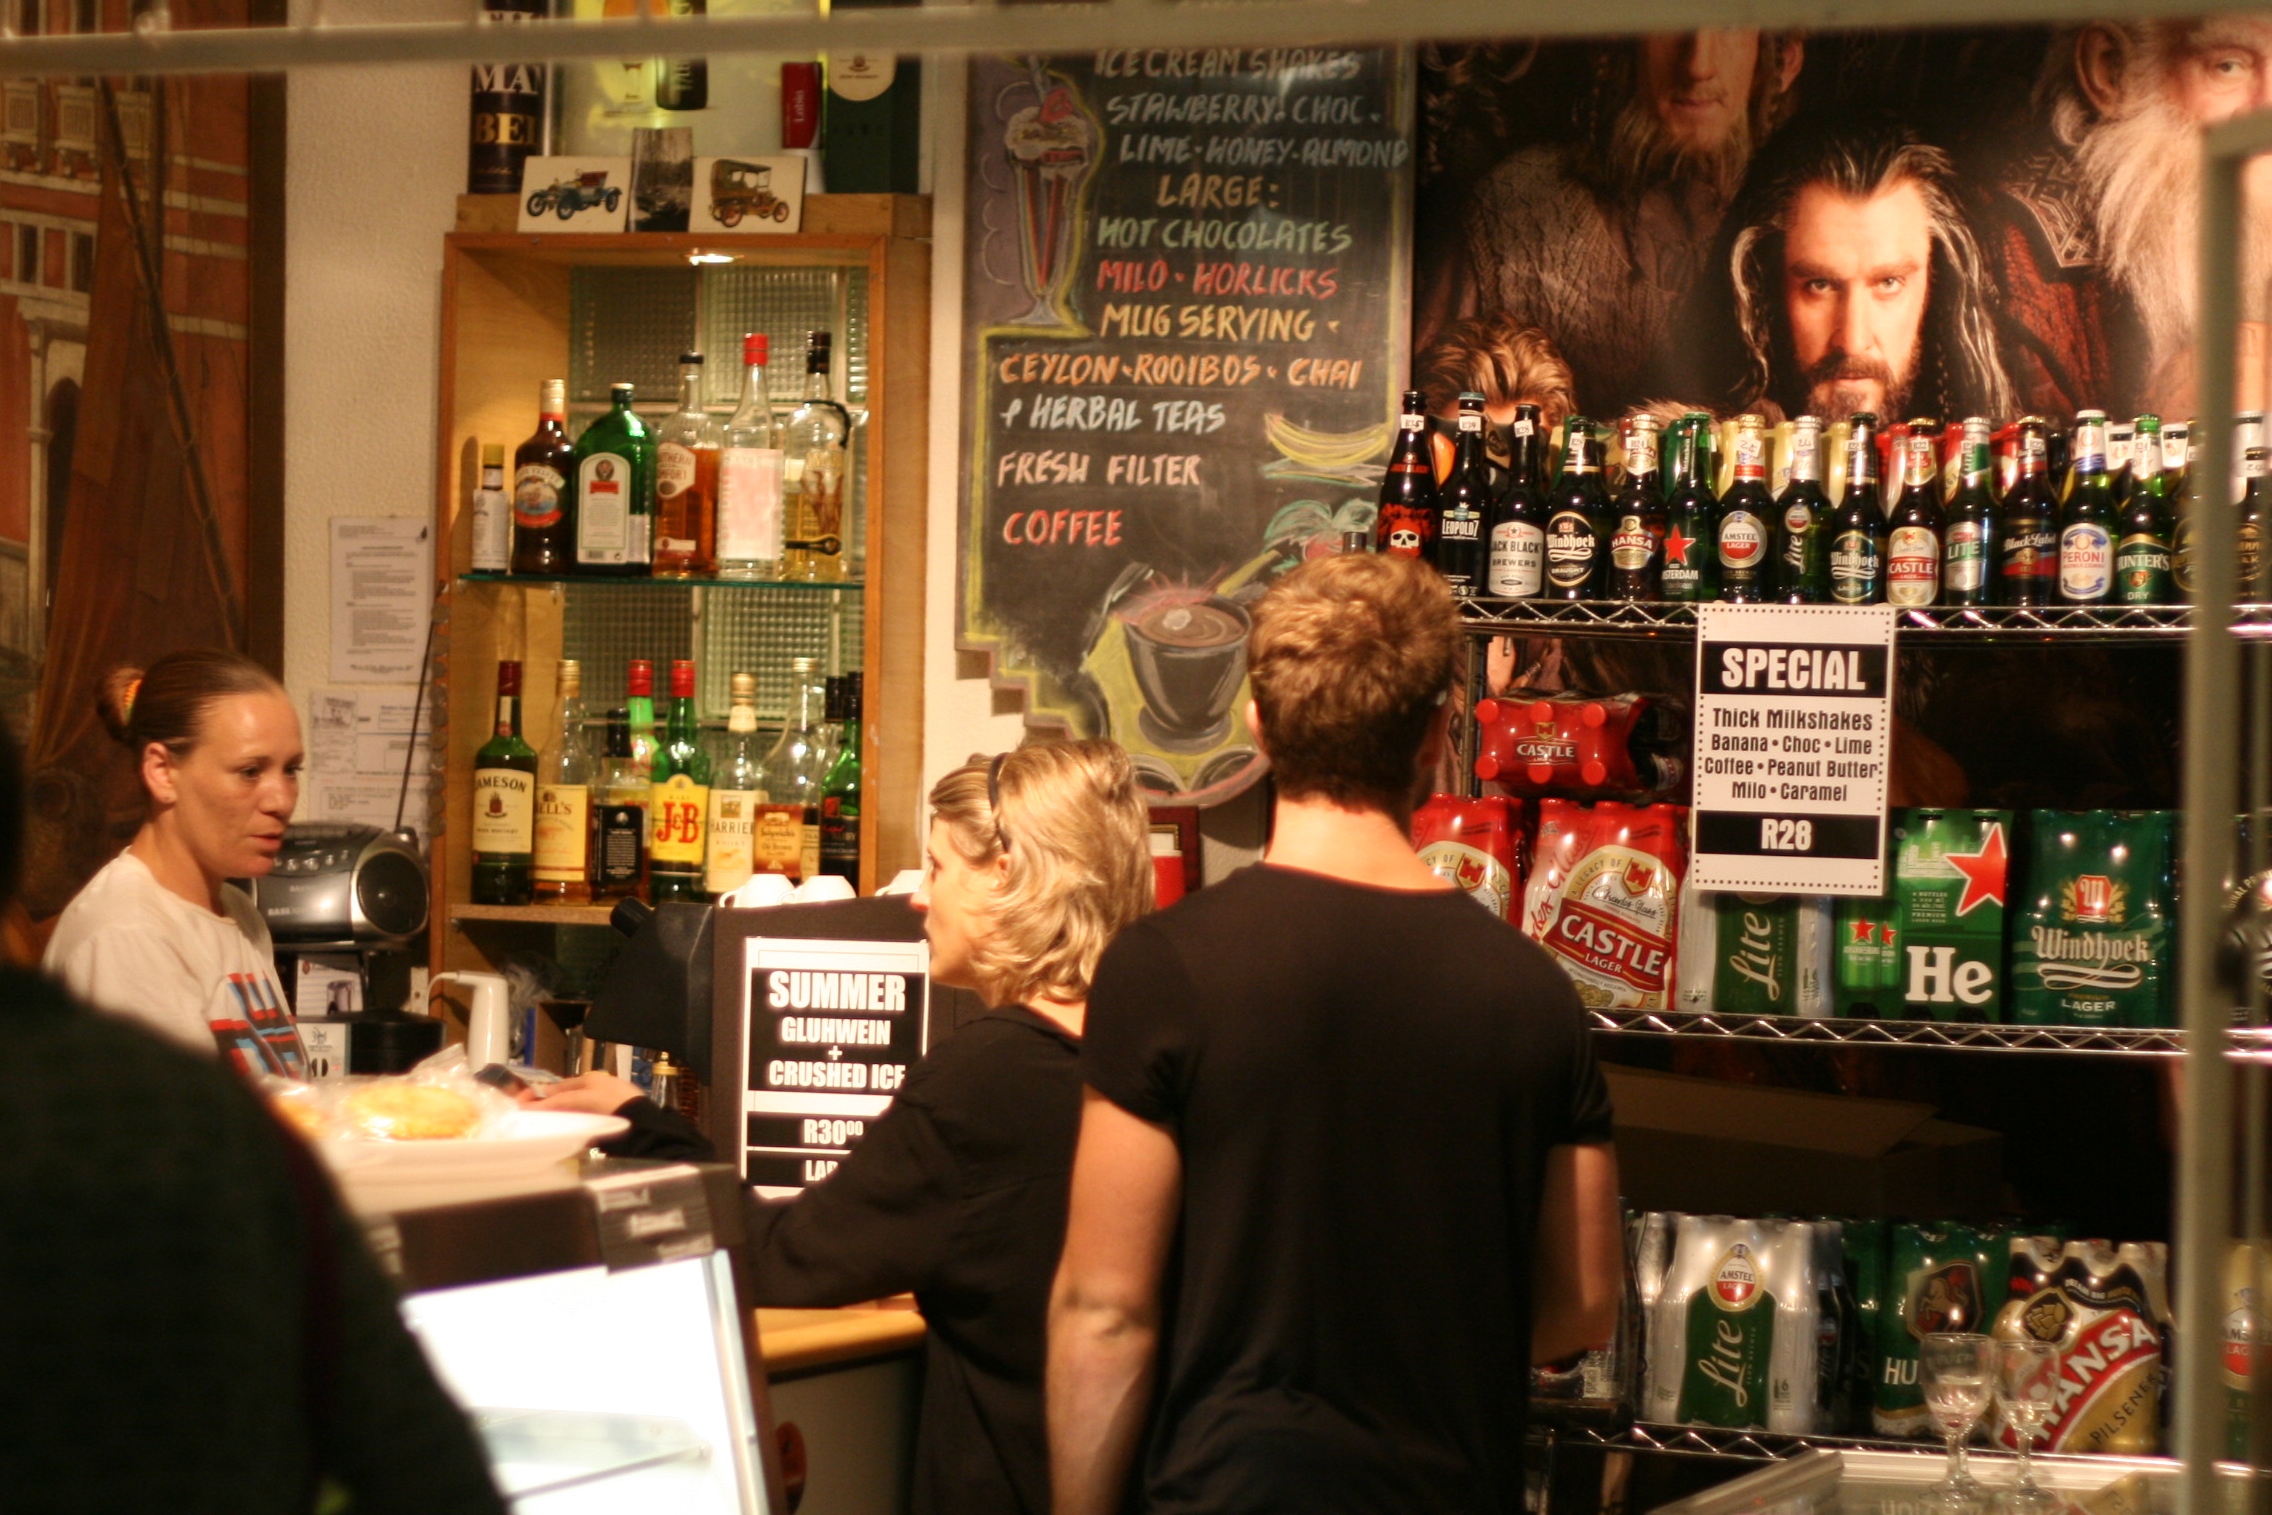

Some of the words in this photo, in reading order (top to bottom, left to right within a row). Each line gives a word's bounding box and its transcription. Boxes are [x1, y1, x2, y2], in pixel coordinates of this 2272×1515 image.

[1097, 216, 1151, 247] HOT
[1162, 218, 1353, 254] CHOCOLATES
[1096, 259, 1169, 293] MILO
[1193, 262, 1339, 300] HORLICKS
[1101, 304, 1171, 338] MUG
[1179, 304, 1315, 342] SERVING
[1287, 358, 1363, 390] CHAI
[1030, 393, 1143, 431] HERBAL
[1153, 400, 1226, 435] TEAS
[998, 449, 1090, 487] FRESH
[1107, 453, 1201, 486] FILTER
[1003, 509, 1123, 547] COFFEE
[1723, 531, 1757, 541] AMSTEL
[1547, 533, 1596, 551] Windhoek
[1611, 535, 1654, 550] HANSA
[1726, 541, 1751, 550] LAGER
[1947, 540, 1981, 560] LITE
[1492, 558, 1538, 569] BREWERS
[1830, 551, 1879, 569] Windhoek
[1889, 561, 1934, 574] CASTLE
[2062, 551, 2105, 564] PERONI
[2127, 591, 2150, 600] DRY
[1721, 648, 1866, 690] SPECIAL
[1713, 708, 1760, 729] Thick
[1767, 709, 1873, 732] Milkshakes
[1516, 743, 1576, 759] CASTLE
[1711, 734, 1768, 752] Banana
[1782, 735, 1821, 754] Choc
[1835, 737, 1872, 755] Lime
[1704, 757, 1754, 776] Coffee
[1767, 758, 1821, 778] Peanut
[1827, 760, 1878, 779] Butter
[1732, 781, 1767, 799] Milo
[1780, 782, 1848, 802] Caramel
[1761, 818, 1812, 851] R28
[1560, 914, 1664, 977] CASTLE
[1729, 911, 1781, 1001] Lite
[2031, 925, 2150, 970] Windhoek
[1585, 952, 1623, 973] LAGER
[1905, 945, 1994, 1005] He
[768, 970, 906, 1012] SUMMER
[2061, 999, 2117, 1013] LAGER
[781, 1016, 891, 1046] GLUHWEIN
[828, 1045, 843, 1061] +
[768, 1060, 867, 1089] CRUSHED
[1720, 1270, 1754, 1282] AMSTEL
[1698, 1319, 1748, 1408] Lite
[2034, 1316, 2158, 1442] HANSA
[2089, 1373, 2158, 1445] PILSENER
